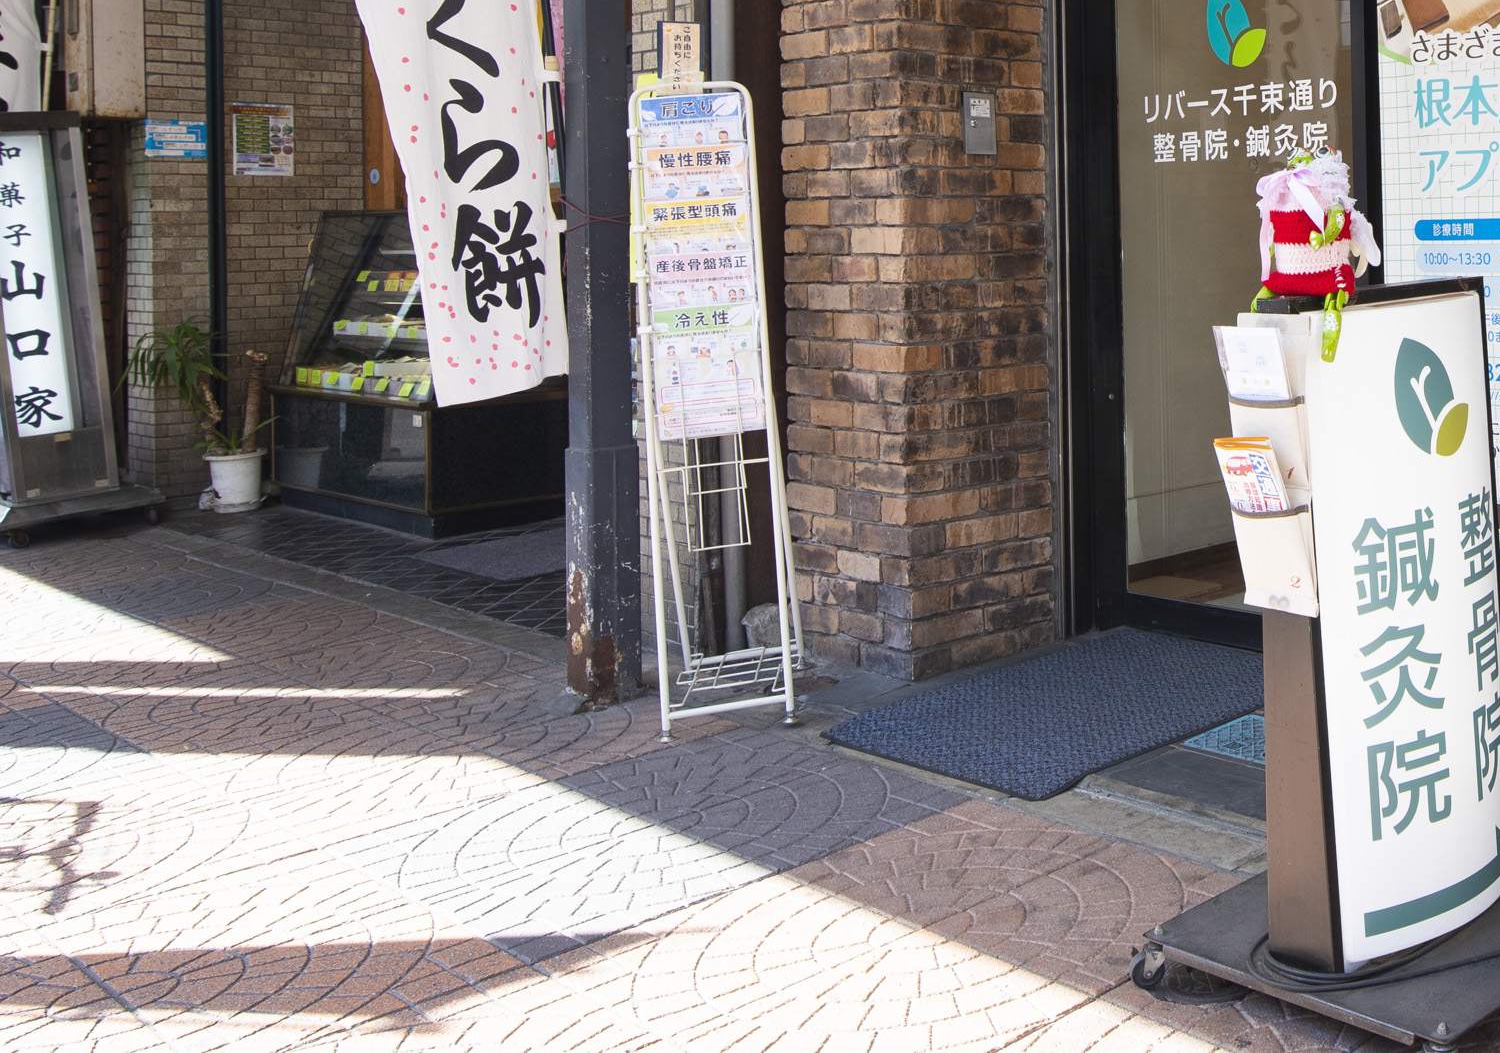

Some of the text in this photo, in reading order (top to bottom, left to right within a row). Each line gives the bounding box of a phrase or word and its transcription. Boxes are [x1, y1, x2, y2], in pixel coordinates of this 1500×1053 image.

[683, 25, 692, 59] ご自由に
[672, 34, 682, 90] お持ちください
[661, 99, 713, 118] 肩こり
[1143, 77, 1337, 123] リバース千束通り
[658, 150, 731, 169] 慢性腰痛
[653, 202, 737, 222] 緊張型頭痛
[1433, 223, 1474, 236] 診療時間
[656, 255, 748, 274] 産後骨盤矯正
[674, 309, 730, 329] 冷え性
[1351, 506, 1452, 842] 鍼灸院
